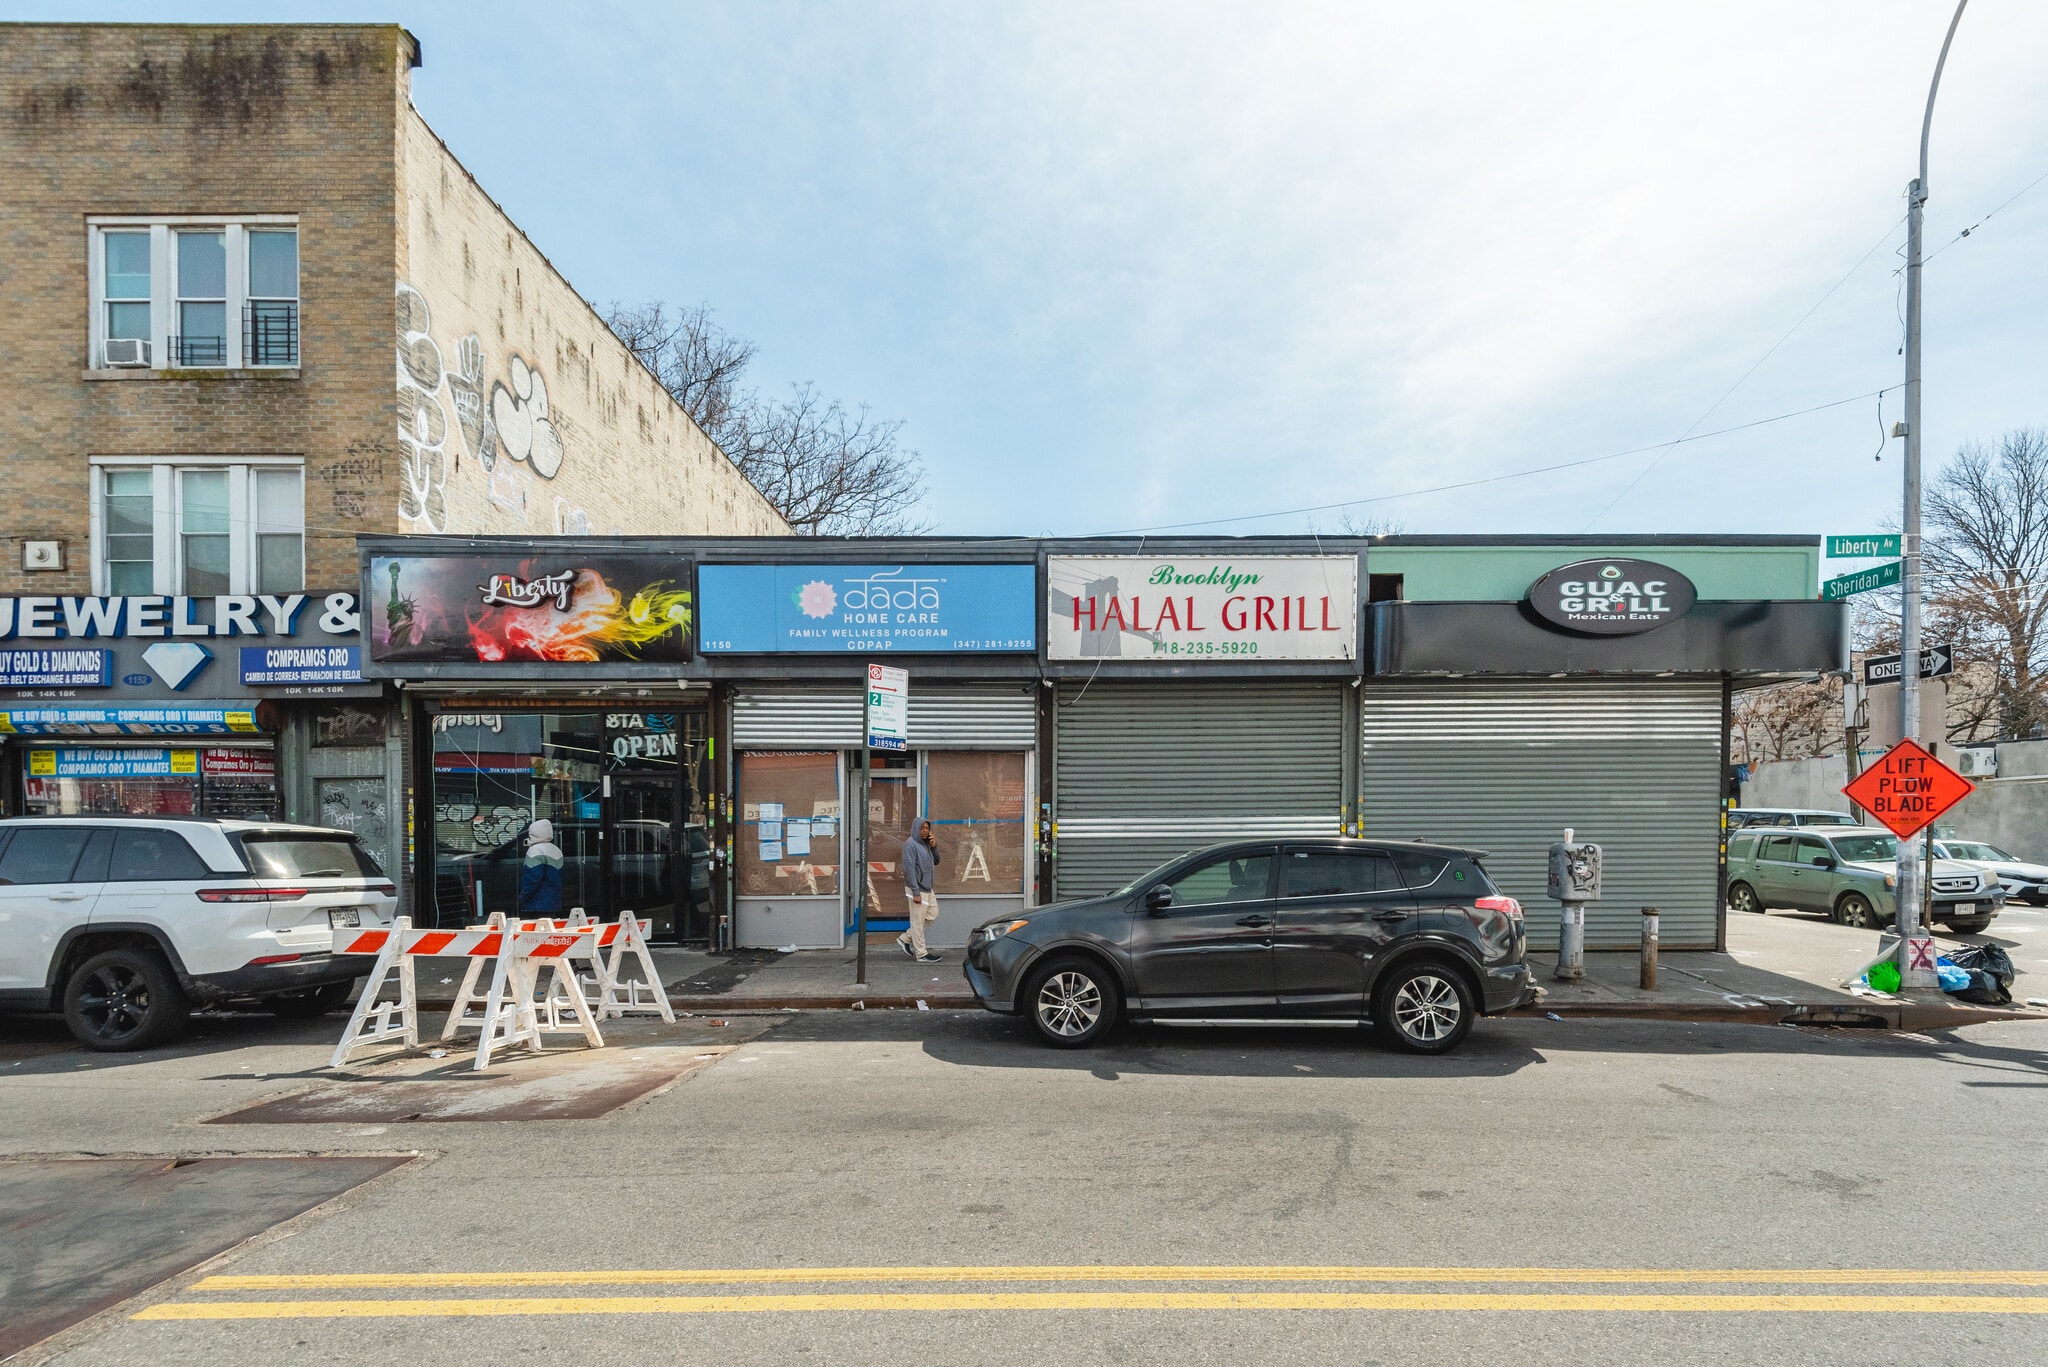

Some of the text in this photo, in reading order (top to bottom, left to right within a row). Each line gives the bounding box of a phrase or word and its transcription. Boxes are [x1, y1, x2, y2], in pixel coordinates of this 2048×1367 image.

[1835, 538, 1893, 556] Liberty Av
[1149, 564, 1264, 593] Brooklyn
[1830, 567, 1894, 598] Sheridan Av
[478, 569, 575, 611] Liberty
[844, 566, 939, 609] dada
[1560, 581, 1668, 597] GUAC
[1609, 593, 1625, 602] &
[318, 592, 360, 634] &
[844, 613, 939, 624] HOME CARE
[1072, 596, 1342, 632] HALAL GRILL
[789, 629, 948, 637] FAMILY WELLNESS PROGRAM
[705, 641, 732, 649] 1150
[847, 641, 893, 650] CDPAP
[953, 639, 1032, 650] (347) 281-9255
[1152, 641, 1258, 655] 718-235-5920
[13, 651, 40, 673] GOLD
[42, 651, 49, 672] &
[51, 650, 101, 672] DIAMONDS
[266, 648, 349, 668] COMPRAMOS ORO
[245, 672, 266, 682] CAMBIO
[266, 671, 274, 681] DE
[301, 670, 334, 681] REPARACION
[334, 670, 342, 680] DE
[1875, 663, 1901, 677] ONE
[10, 675, 28, 685] BELT
[28, 674, 64, 685] EXCHANGE
[72, 674, 100, 684] REPAIRS
[128, 675, 148, 685] 1152
[872, 693, 879, 705] 2
[12, 711, 25, 722] WE
[25, 711, 40, 722] BUY
[40, 711, 60, 722] GOLD
[66, 710, 106, 721] DIAMONDS
[118, 710, 165, 721] COMPRAMOS
[165, 710, 181, 721] ORO
[181, 710, 187, 721] Y
[187, 710, 223, 721] DIAMATES
[613, 733, 677, 759] OPEN
[874, 739, 896, 749] 318594
[64, 750, 163, 762] WE BUY GOLD & DIAMONDS
[217, 749, 229, 760] Buy
[58, 762, 169, 774] COMPRAMOS ORO Y DIAMATES
[206, 759, 239, 770] Compramos
[239, 760, 249, 770] Oro
[1885, 758, 1928, 774] LIFT
[1880, 776, 1933, 793] PLOW
[1874, 796, 1937, 812] BLADE
